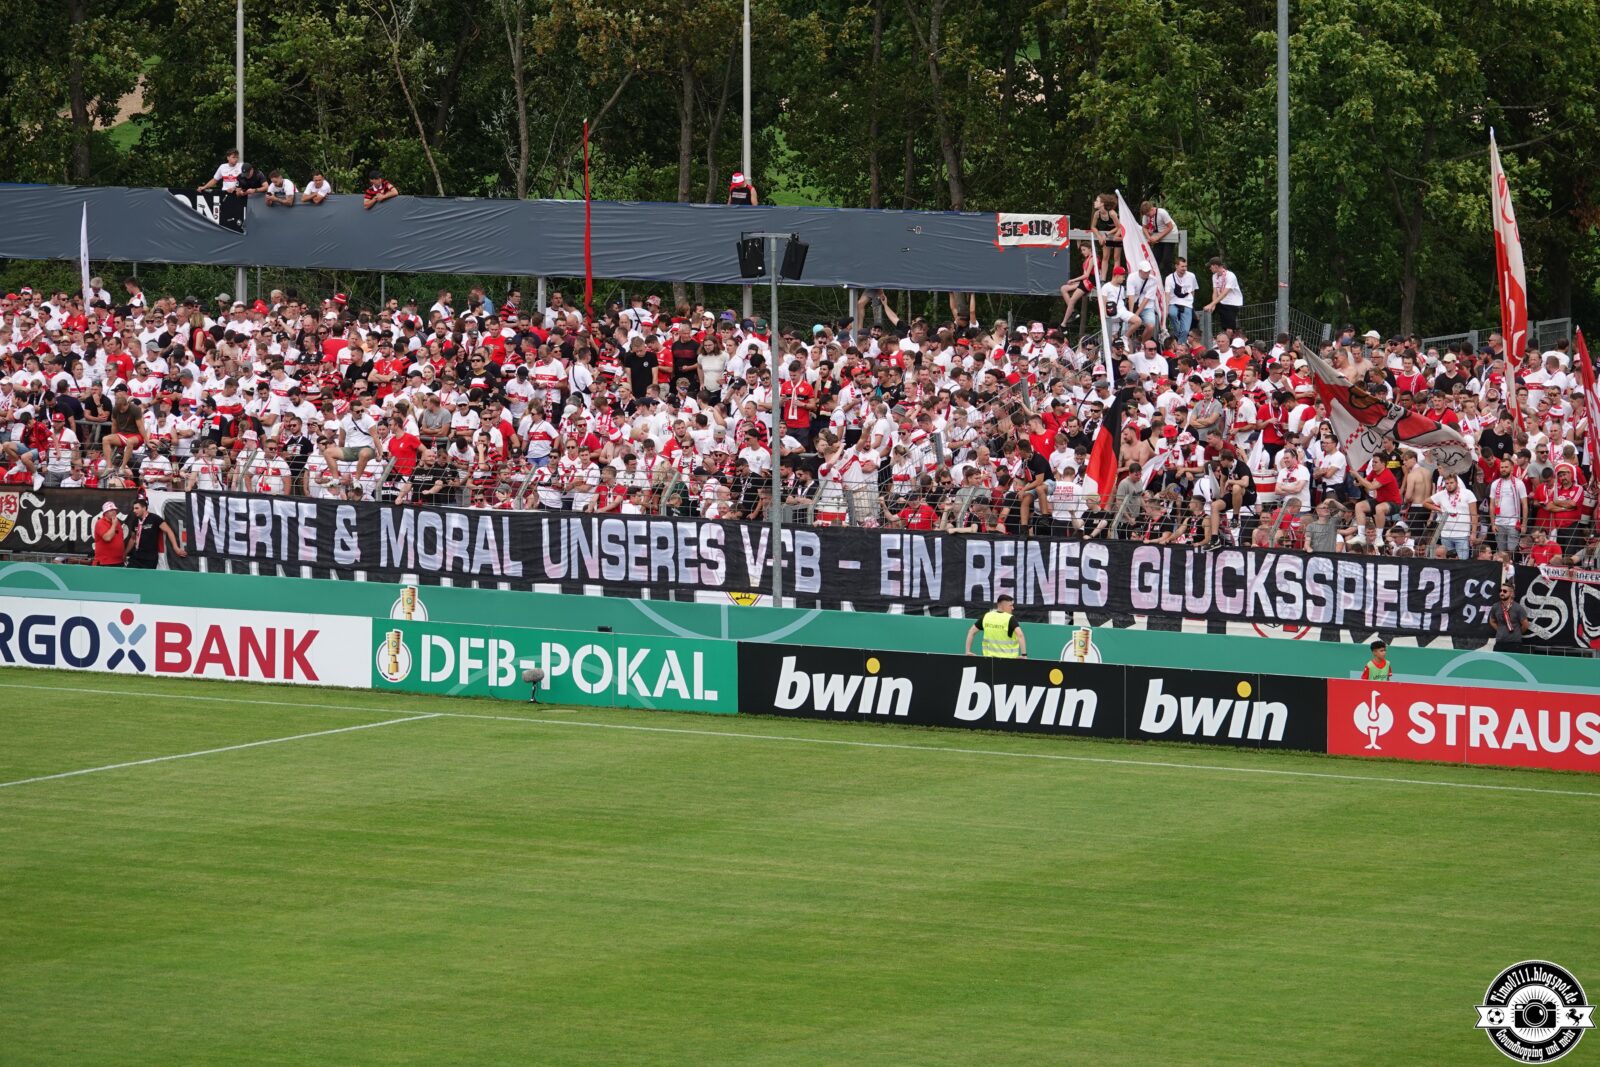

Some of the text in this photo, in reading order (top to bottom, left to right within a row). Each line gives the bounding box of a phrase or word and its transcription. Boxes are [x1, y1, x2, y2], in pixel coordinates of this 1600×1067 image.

[191, 492, 317, 562] WERTE
[333, 505, 361, 564] &
[379, 507, 523, 577] MORAL
[542, 517, 726, 586] UNSERES
[838, 560, 861, 569] -
[880, 533, 943, 600] EIN
[965, 539, 1109, 606] REINES
[1130, 545, 1451, 632] GLÜCKSSPIEL?!
[1463, 578, 1496, 600] CC
[155, 621, 320, 681] BANK
[420, 634, 719, 701] DFB-POKAL
[774, 656, 914, 717] bwin
[954, 666, 1098, 728] bwin
[1139, 678, 1288, 742] bwin
[1406, 701, 1600, 756] STRAUS
